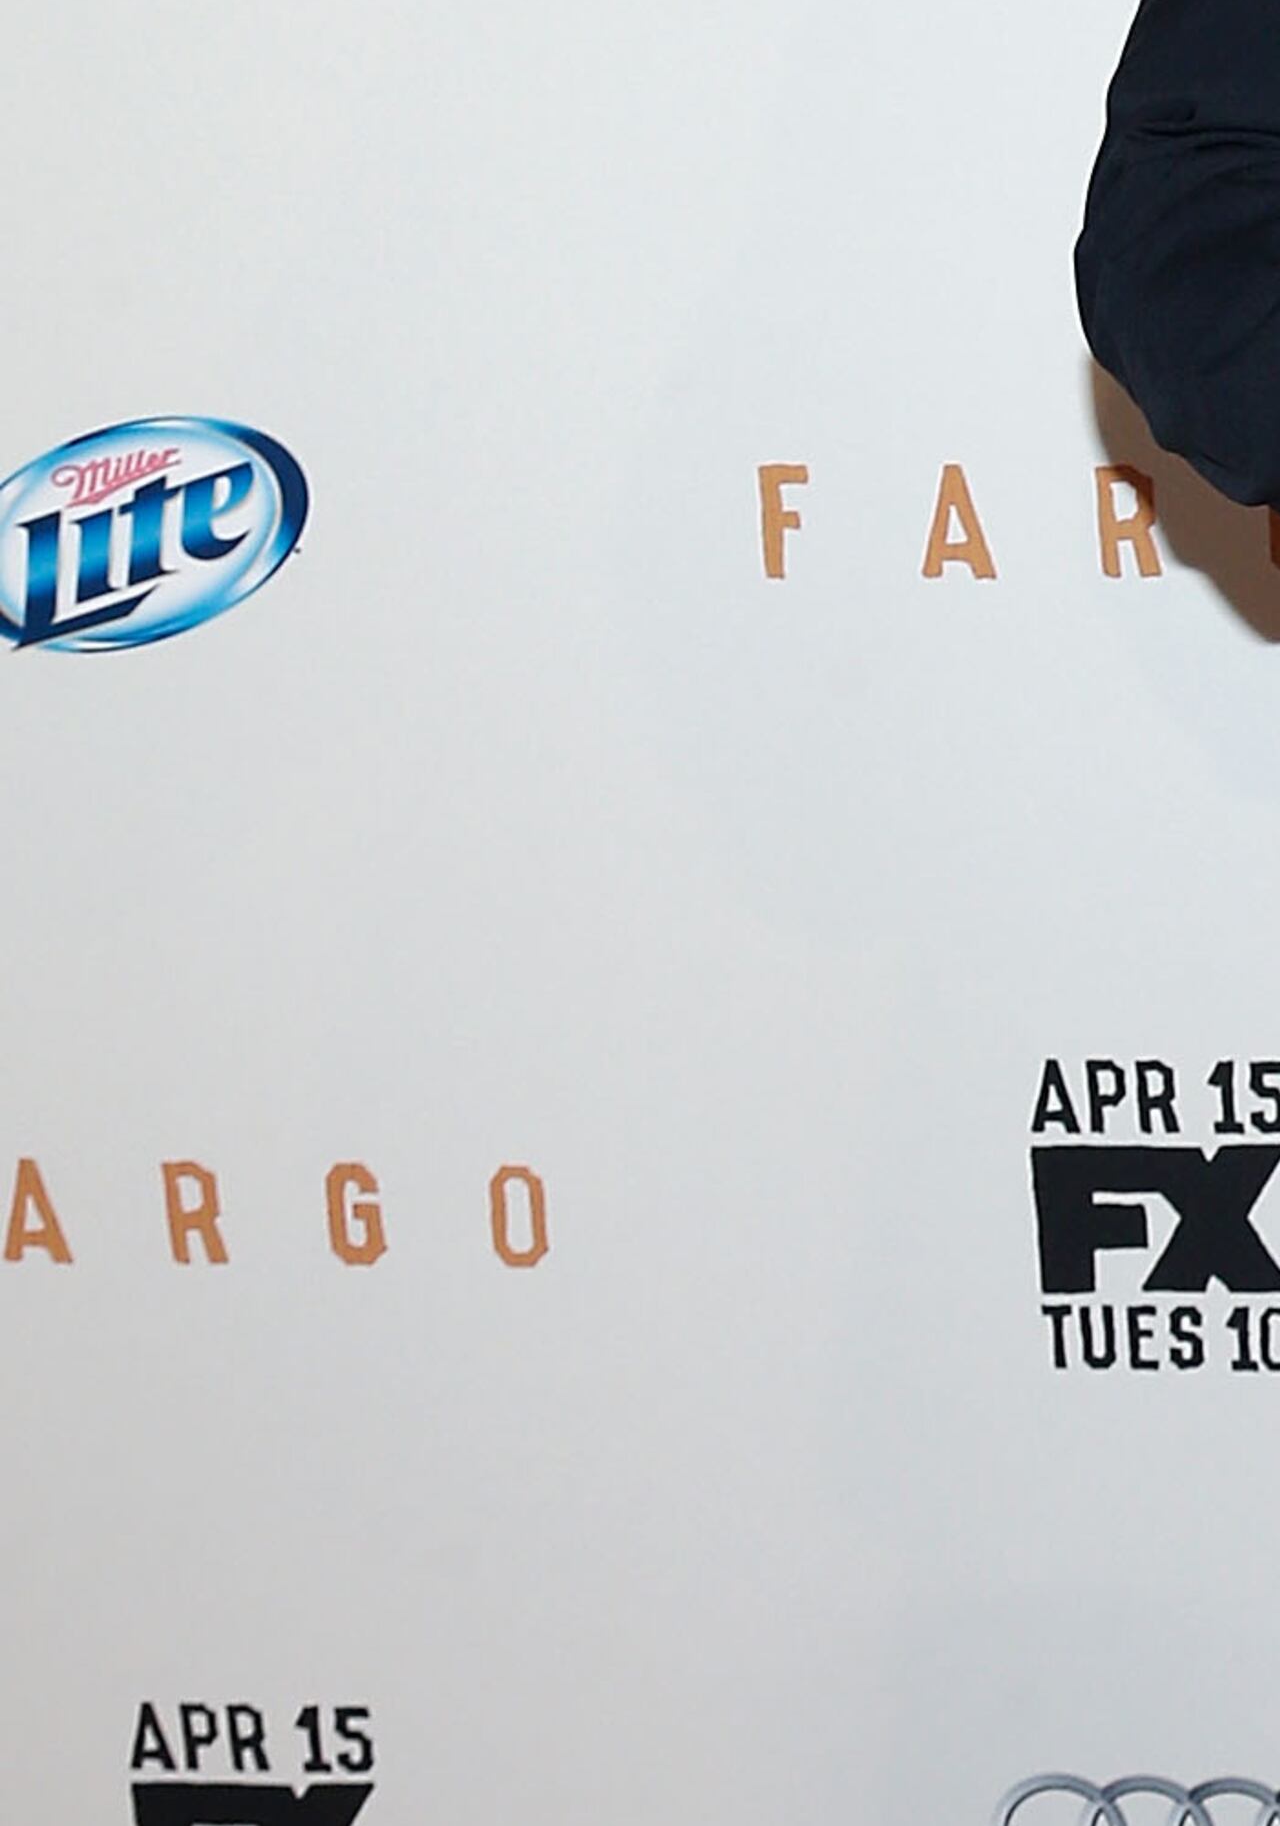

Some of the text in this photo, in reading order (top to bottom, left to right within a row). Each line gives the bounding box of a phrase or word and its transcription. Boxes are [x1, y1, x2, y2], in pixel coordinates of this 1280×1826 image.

[51, 447, 182, 509] Miller
[12, 461, 254, 651] Lite
[1031, 1059, 1181, 1135] APR
[4, 1158, 549, 1268] ARGO
[1041, 1304, 1205, 1371] TUES
[130, 1701, 376, 1774] APR 15
